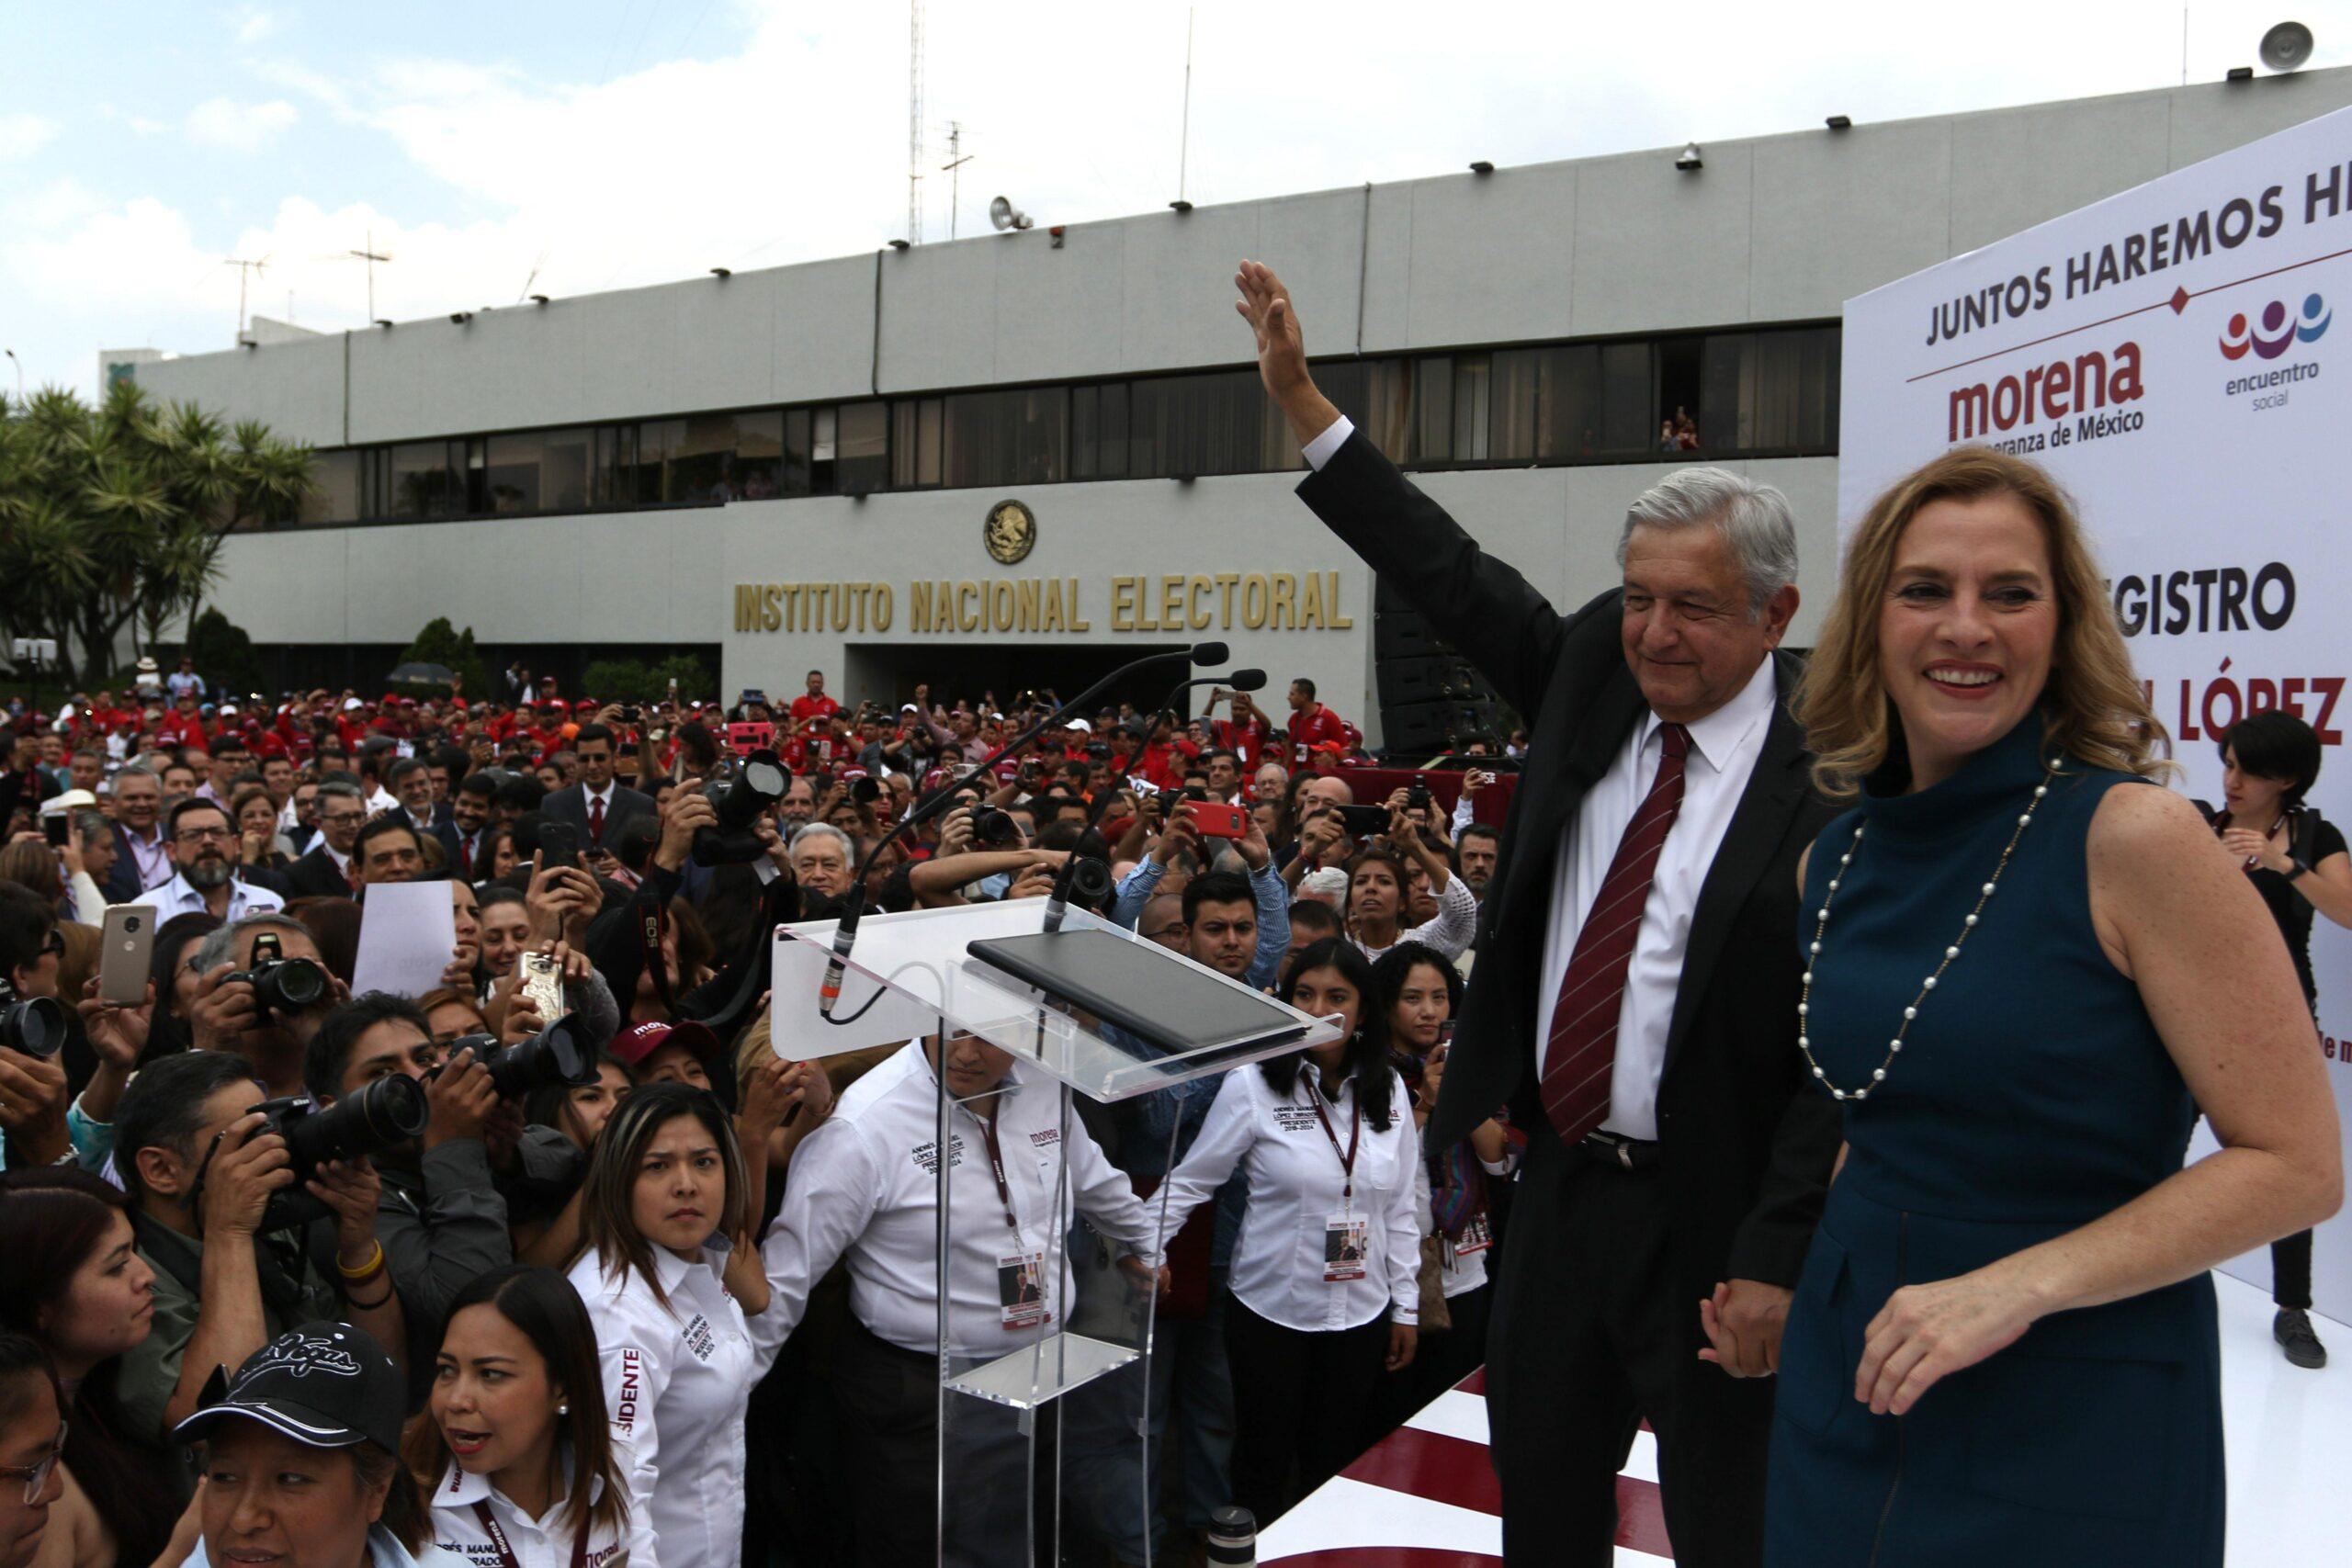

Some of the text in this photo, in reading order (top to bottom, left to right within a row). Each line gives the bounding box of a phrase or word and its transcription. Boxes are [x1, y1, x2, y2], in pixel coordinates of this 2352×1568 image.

[1926, 265, 2052, 346] JUNTOS
[2065, 185, 2284, 300] HAREMOS
[1949, 341, 2144, 443] morena
[2225, 362, 2320, 396] encuentro
[2252, 389, 2290, 412] social
[2051, 421, 2071, 447] de
[2077, 409, 2144, 443] México
[734, 570, 1353, 633] INSTITUTO NACIONAL ELECTORAL
[2105, 561, 2296, 637] GISTRO
[645, 917, 659, 948] EOS
[617, 1349, 639, 1437] SIDENTE
[489, 1520, 509, 1554] morena
